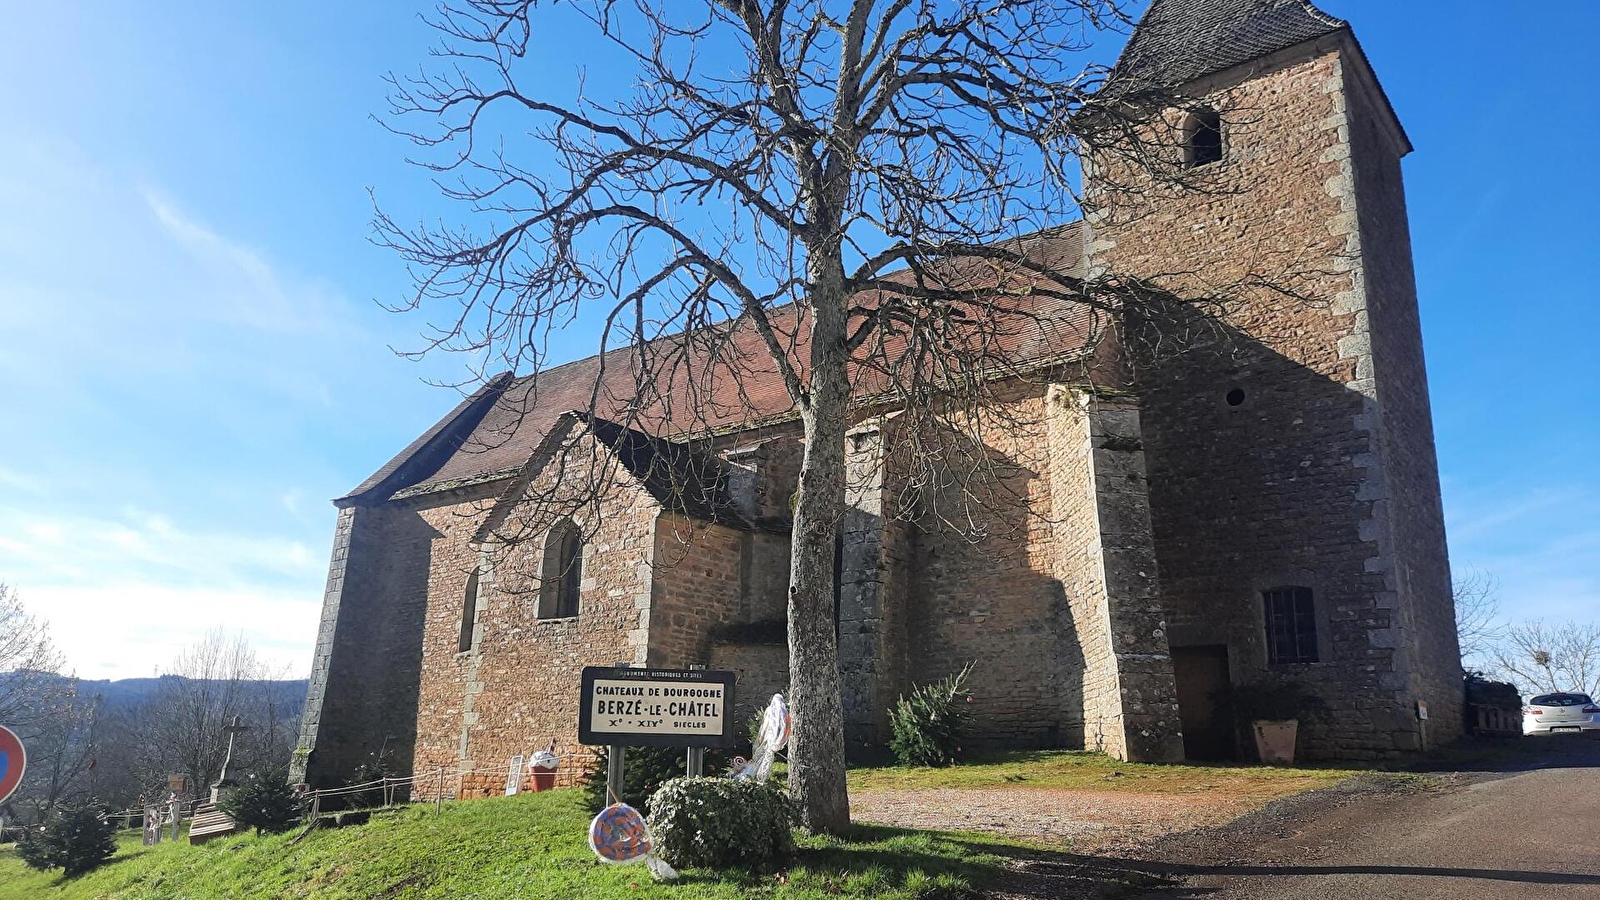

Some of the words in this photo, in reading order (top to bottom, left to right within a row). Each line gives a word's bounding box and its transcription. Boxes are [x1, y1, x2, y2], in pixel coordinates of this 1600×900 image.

[596, 686, 644, 696] CHATEAUX
[648, 687, 660, 696] DE
[663, 688, 721, 698] BOURGOGNE
